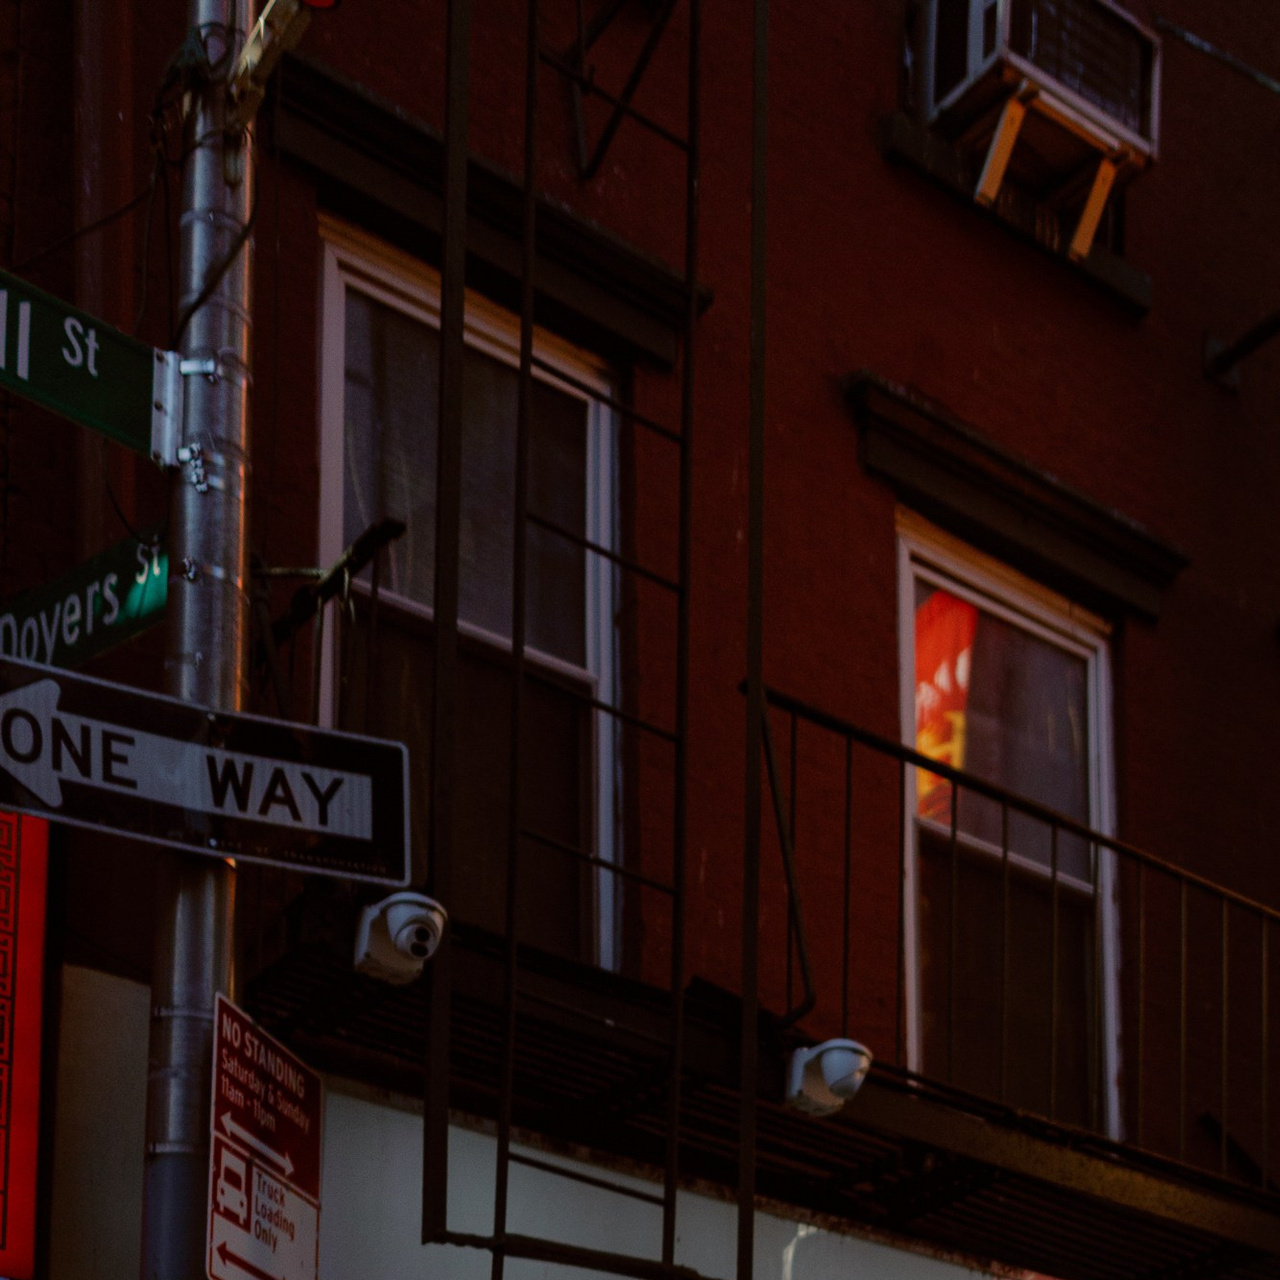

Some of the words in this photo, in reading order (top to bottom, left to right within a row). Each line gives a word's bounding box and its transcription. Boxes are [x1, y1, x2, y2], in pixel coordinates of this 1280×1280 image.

[61, 315, 100, 380] St
[135, 534, 162, 585] St
[1, 708, 137, 790] ONE
[206, 754, 344, 826] WAY
[222, 1012, 241, 1050] NO
[244, 1031, 305, 1100] STANDING
[221, 1047, 267, 1102] Saturday
[276, 1089, 311, 1135] Sunday
[256, 1171, 286, 1207] Truck
[254, 1220, 278, 1253] Only
[255, 1201, 295, 1241] Loading
